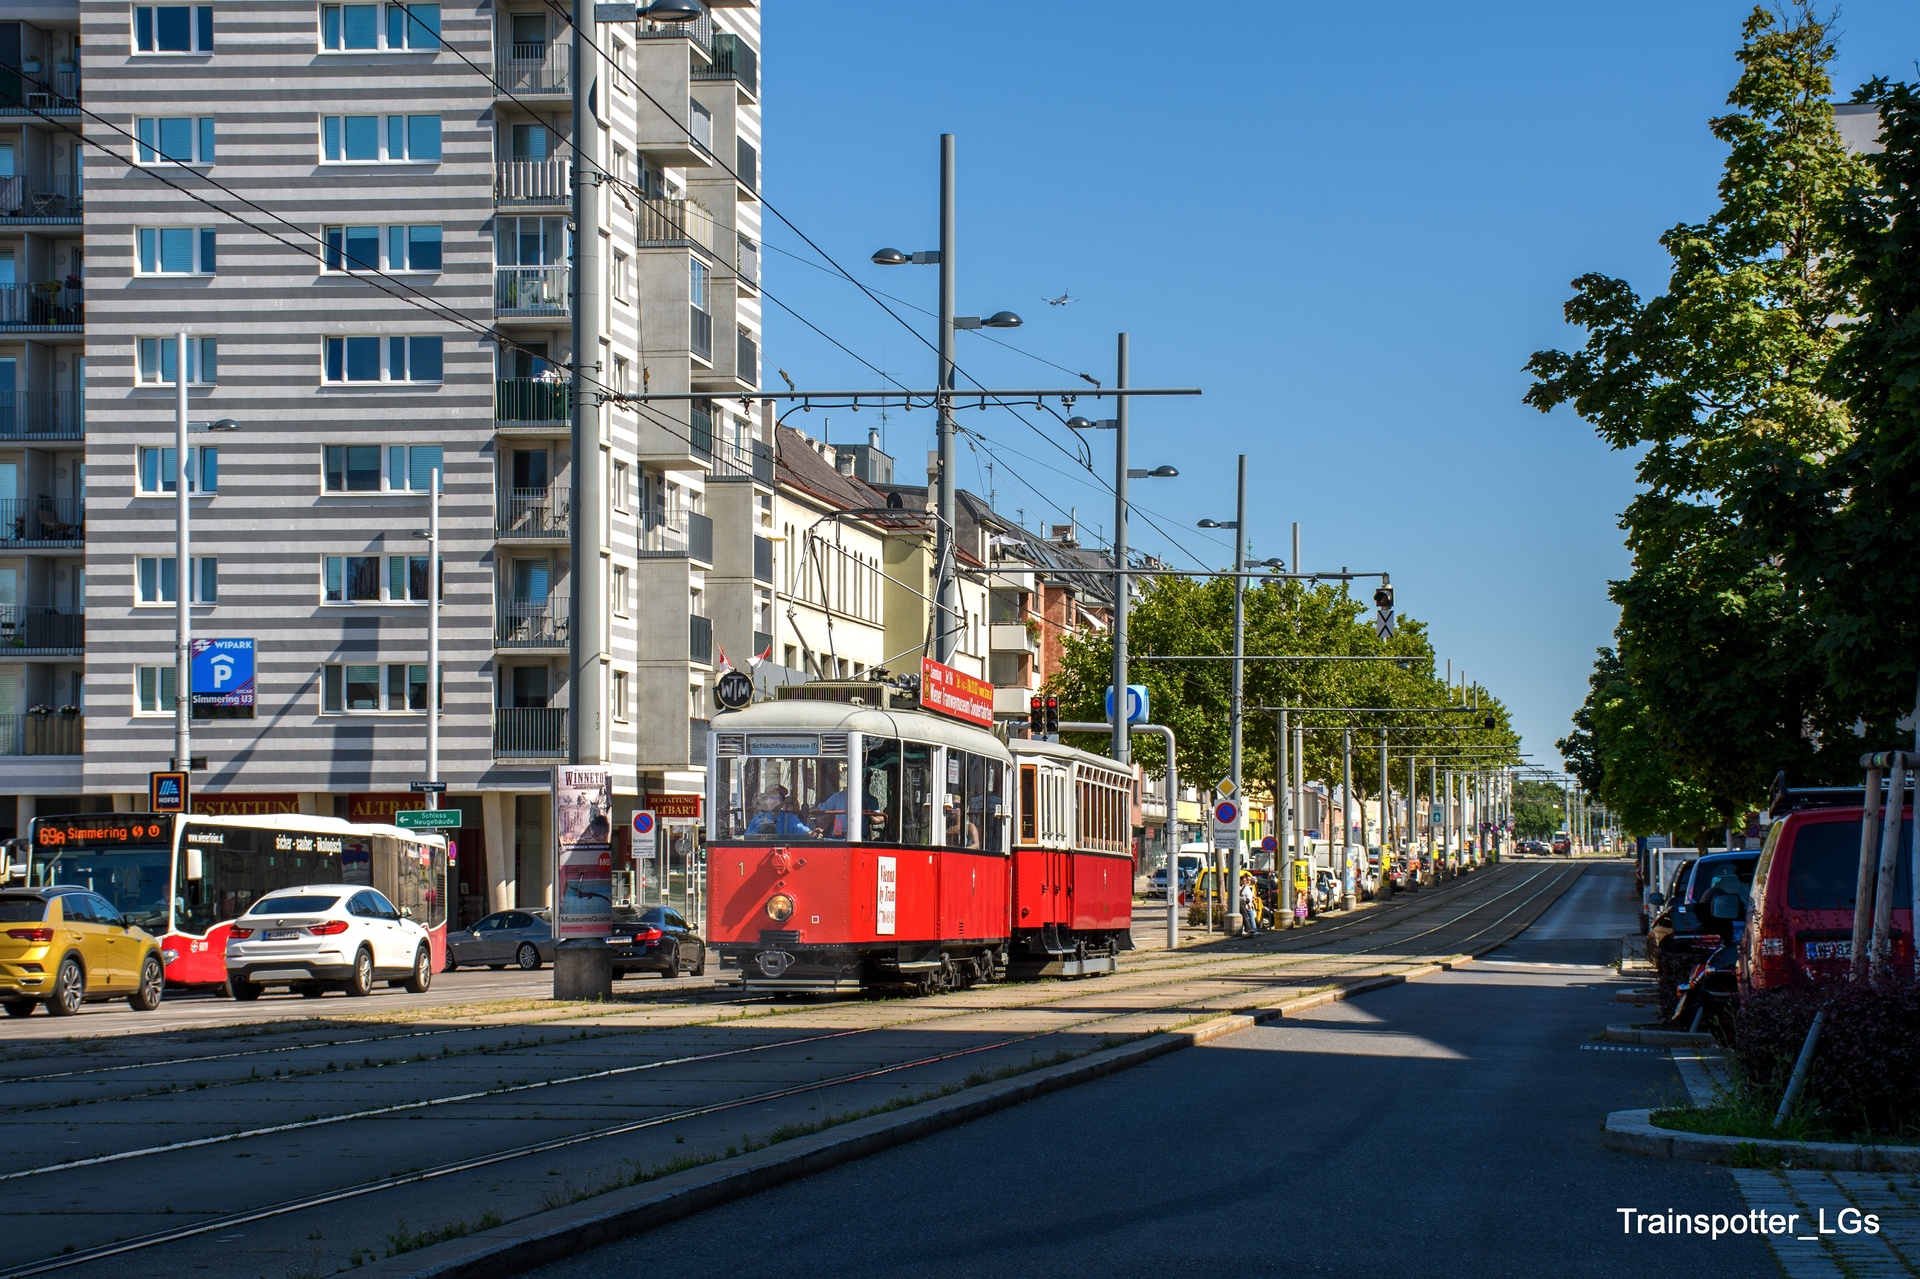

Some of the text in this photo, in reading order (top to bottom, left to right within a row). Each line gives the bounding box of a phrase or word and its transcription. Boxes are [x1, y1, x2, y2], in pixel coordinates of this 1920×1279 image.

[215, 641, 252, 649] WIPARK
[214, 664, 232, 688] P
[721, 676, 751, 701] WTM
[193, 695, 253, 705] Simmering U3
[565, 772, 608, 786] WINNETO
[192, 801, 298, 816] ESTATTUN
[40, 827, 66, 844] 69A
[68, 826, 128, 840] Simmering
[276, 834, 292, 850] sicher
[296, 836, 313, 851] sauber
[738, 862, 744, 876] 1
[880, 864, 894, 882] Vienna
[879, 886, 895, 904] by Tram
